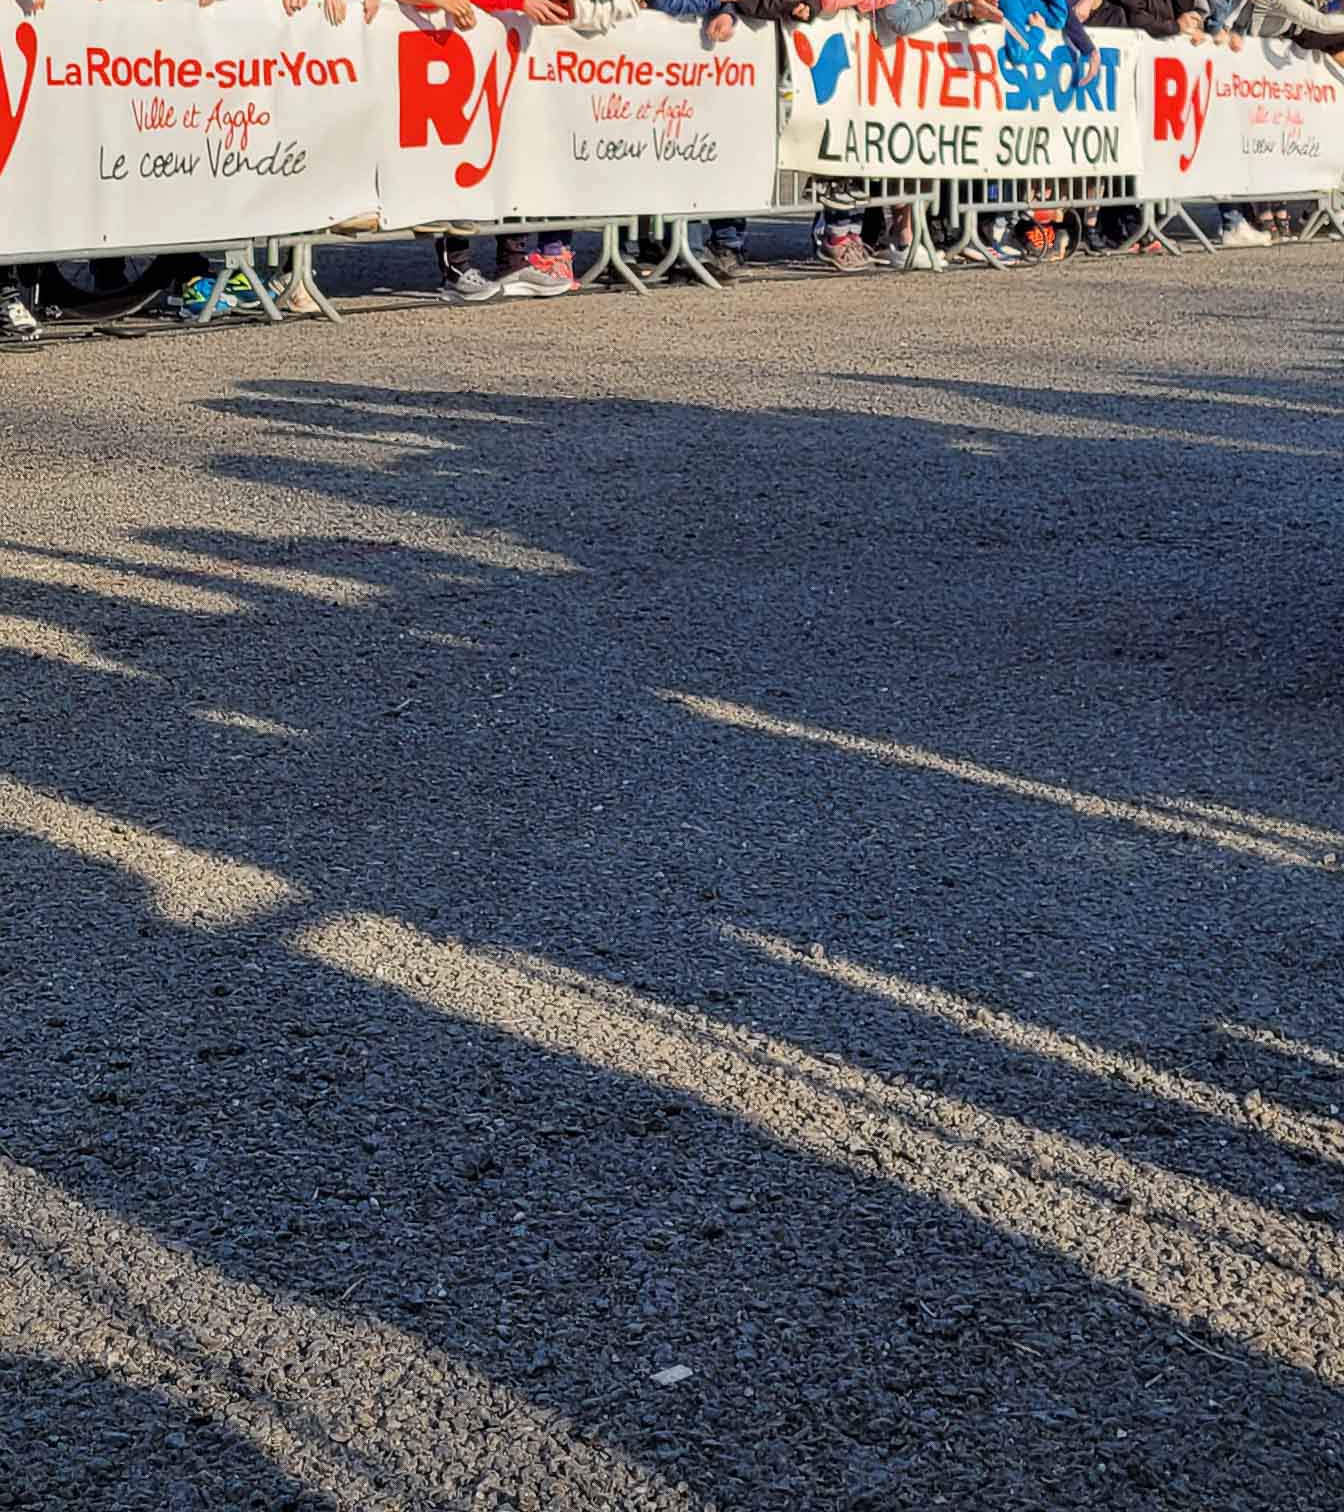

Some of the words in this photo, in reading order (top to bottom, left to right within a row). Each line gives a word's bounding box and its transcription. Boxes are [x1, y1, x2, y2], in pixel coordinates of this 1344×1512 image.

[131, 96, 178, 132] Ville
[183, 104, 202, 129] et
[204, 98, 271, 150] Agglo
[592, 92, 632, 122] Ville
[635, 100, 651, 120] et
[653, 96, 695, 138] Agglo
[99, 144, 128, 180] Le
[205, 137, 307, 178] Vendée
[572, 130, 590, 160] Le
[653, 128, 718, 162] Vendée
[996, 126, 1051, 165] SUR
[1063, 126, 1119, 164] YON
